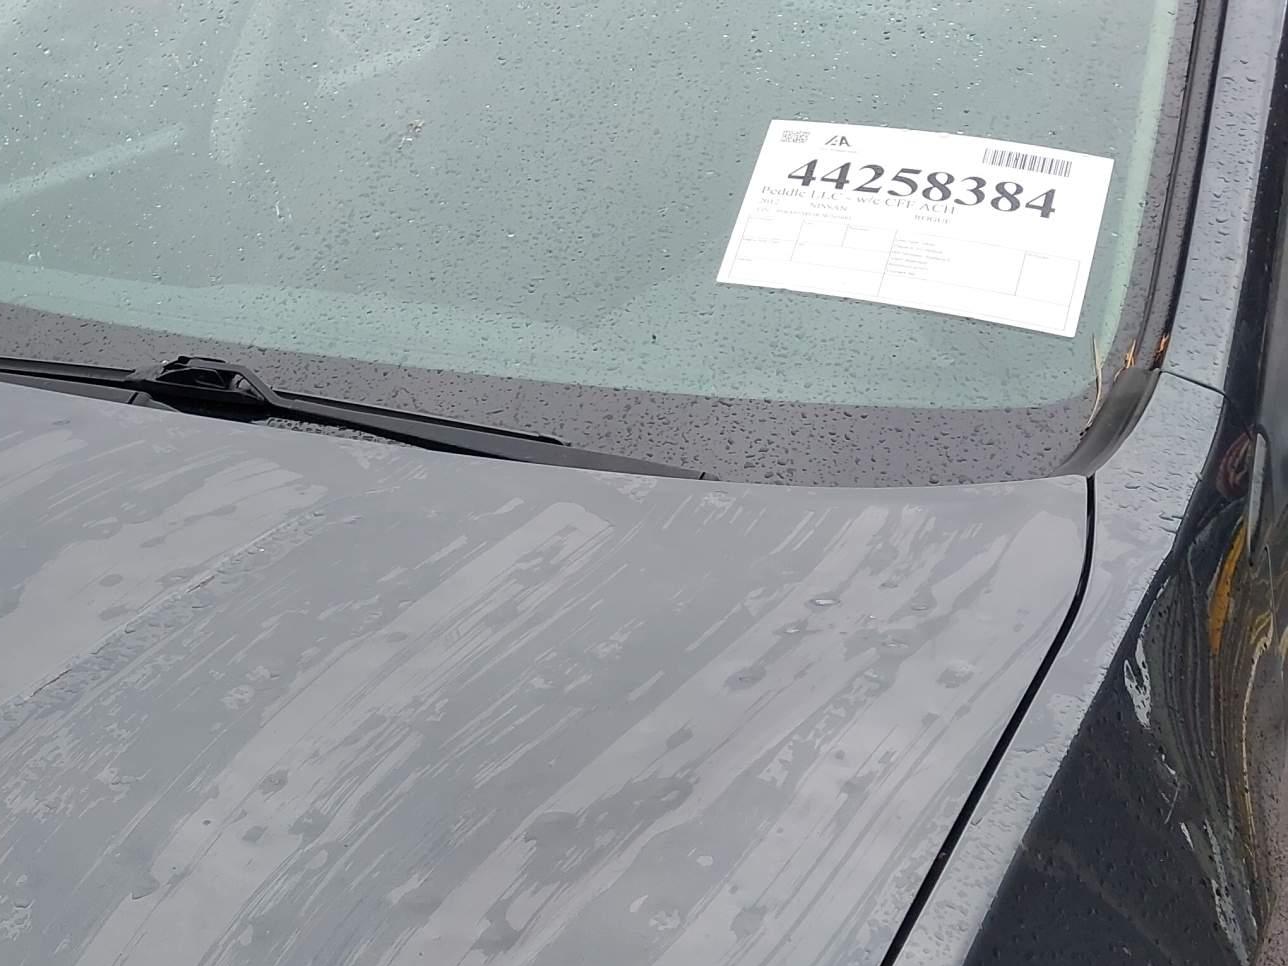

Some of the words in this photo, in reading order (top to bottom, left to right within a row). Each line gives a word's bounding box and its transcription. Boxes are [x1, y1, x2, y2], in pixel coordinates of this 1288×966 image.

[761, 185, 807, 198] Peddle
[810, 189, 844, 201] LLC
[788, 159, 1056, 219] 44258384
